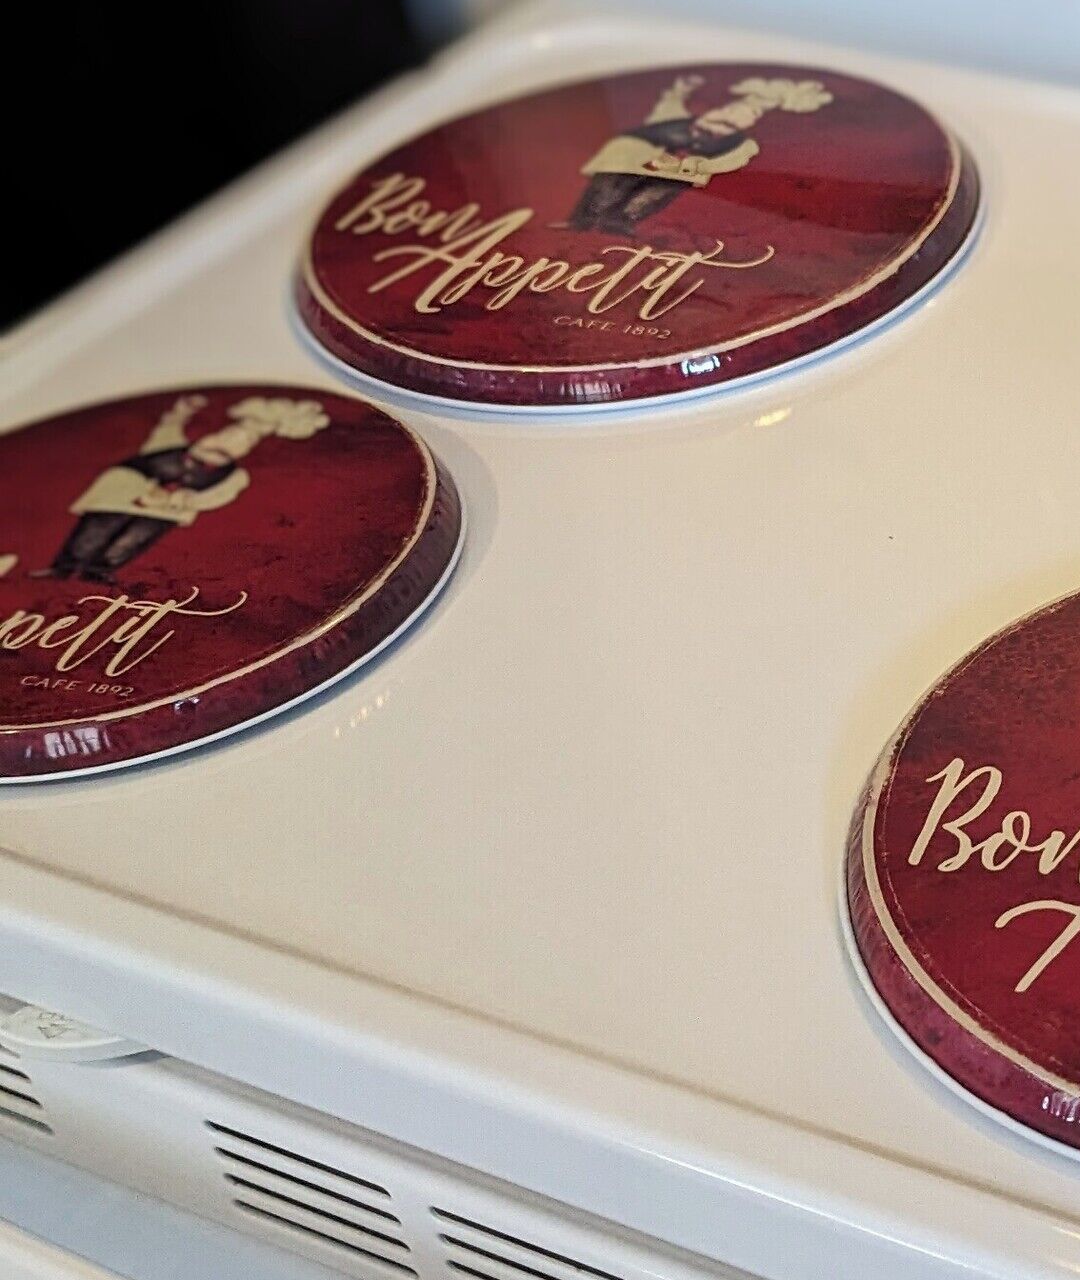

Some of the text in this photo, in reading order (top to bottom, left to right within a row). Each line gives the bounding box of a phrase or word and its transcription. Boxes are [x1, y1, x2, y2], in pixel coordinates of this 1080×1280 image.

[334, 173, 480, 243] Bon
[368, 208, 775, 321] Appetit
[552, 315, 673, 340] CAFE 1892
[0, 586, 248, 677] petit
[20, 675, 135, 697] CAFE 1892
